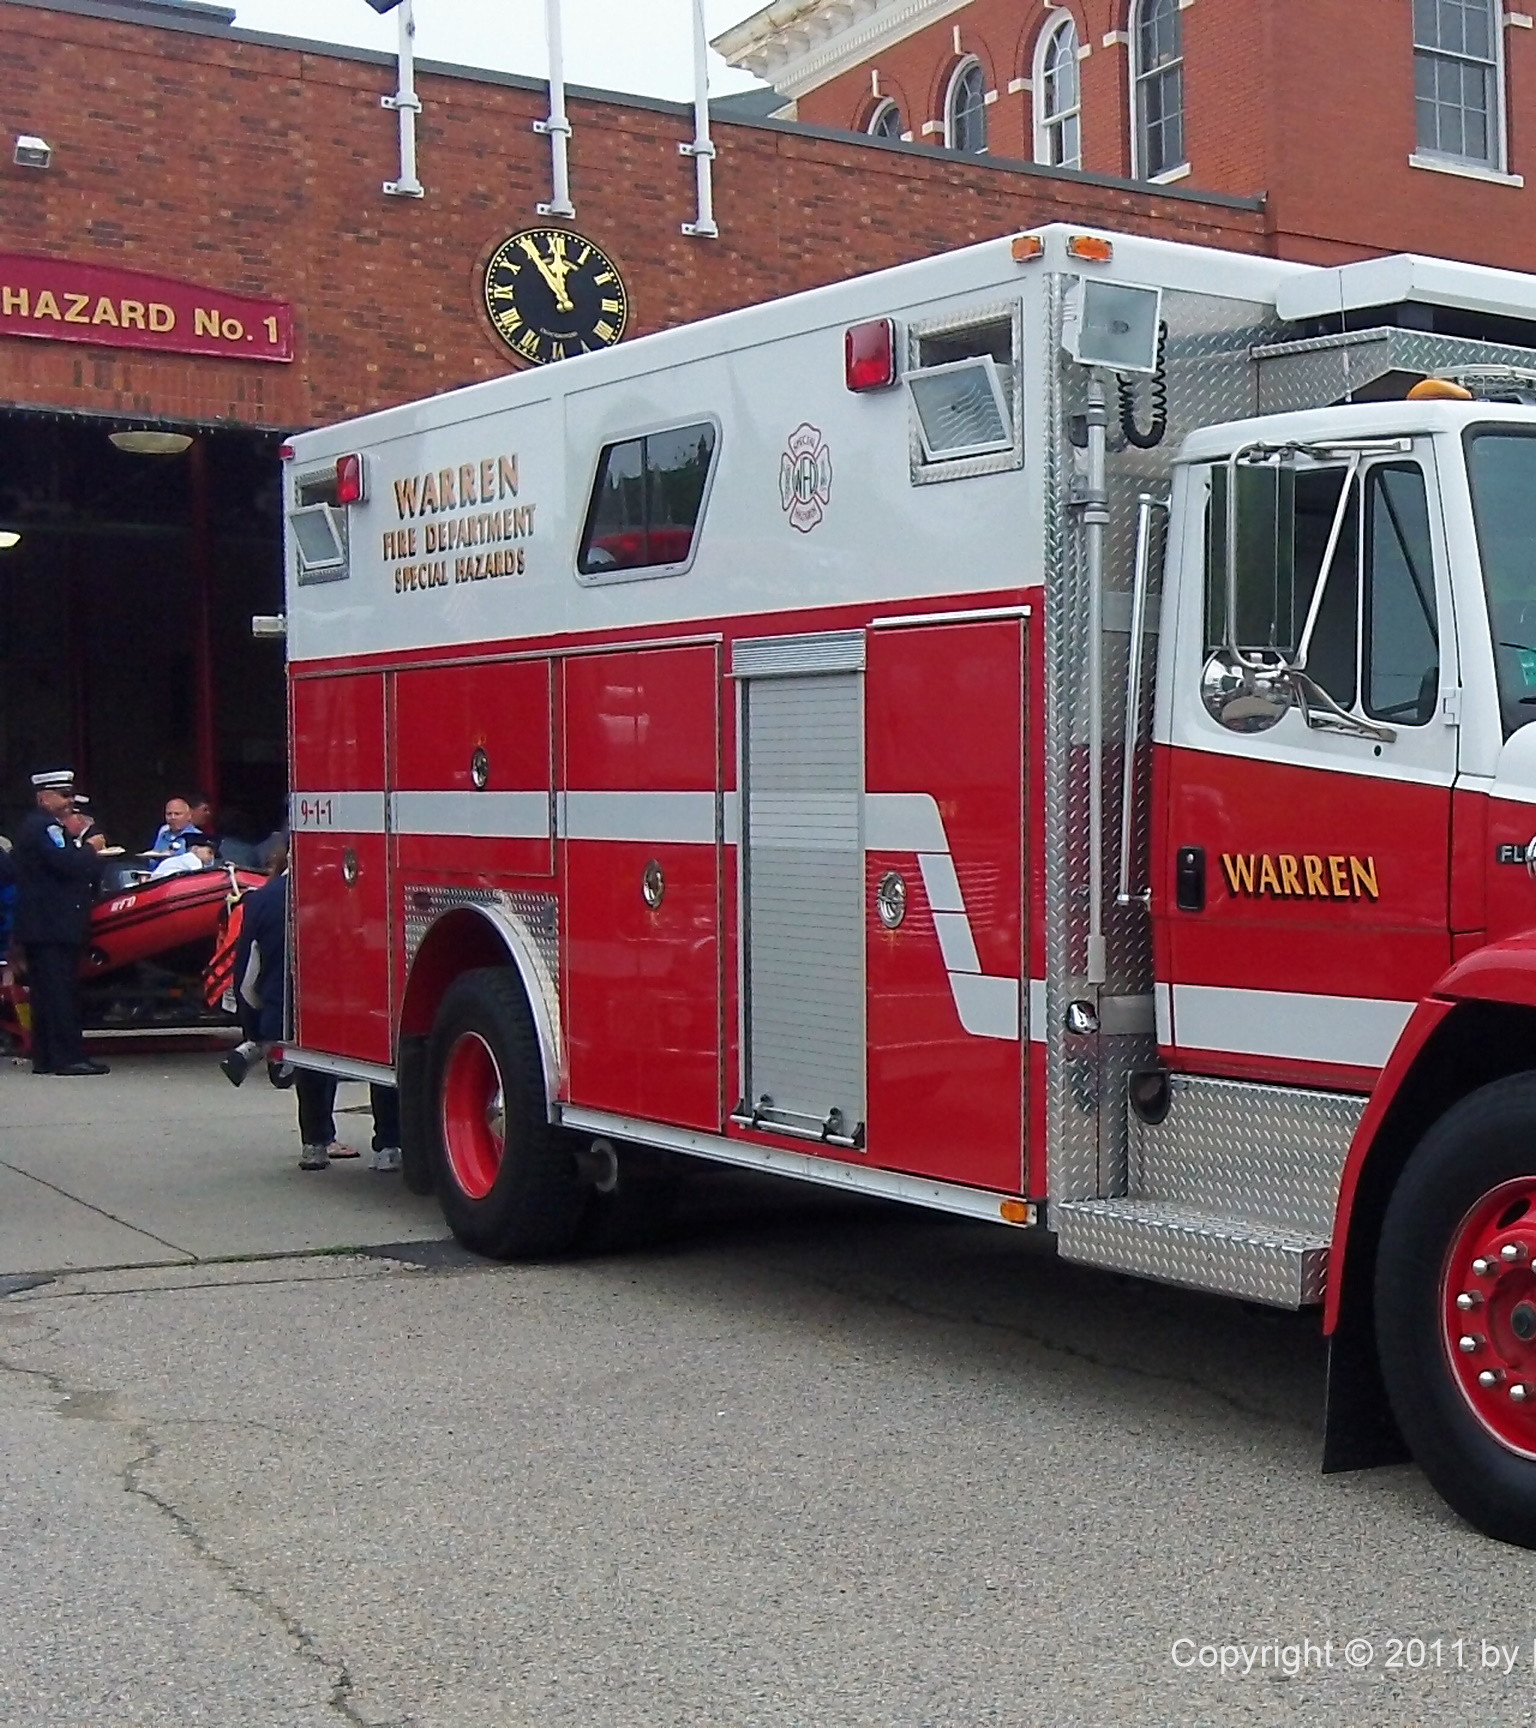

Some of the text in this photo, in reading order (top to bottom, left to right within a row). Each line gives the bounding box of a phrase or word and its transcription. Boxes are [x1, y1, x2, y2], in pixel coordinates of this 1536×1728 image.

[2, 286, 279, 344] HAZARD No. 1
[393, 453, 519, 521] WARREN
[383, 503, 537, 561] FIRE DEPARTMENT
[395, 547, 526, 594] SPECIAL HAZARDS
[301, 799, 333, 825] 9-1-1
[1221, 853, 1380, 901] WARREN
